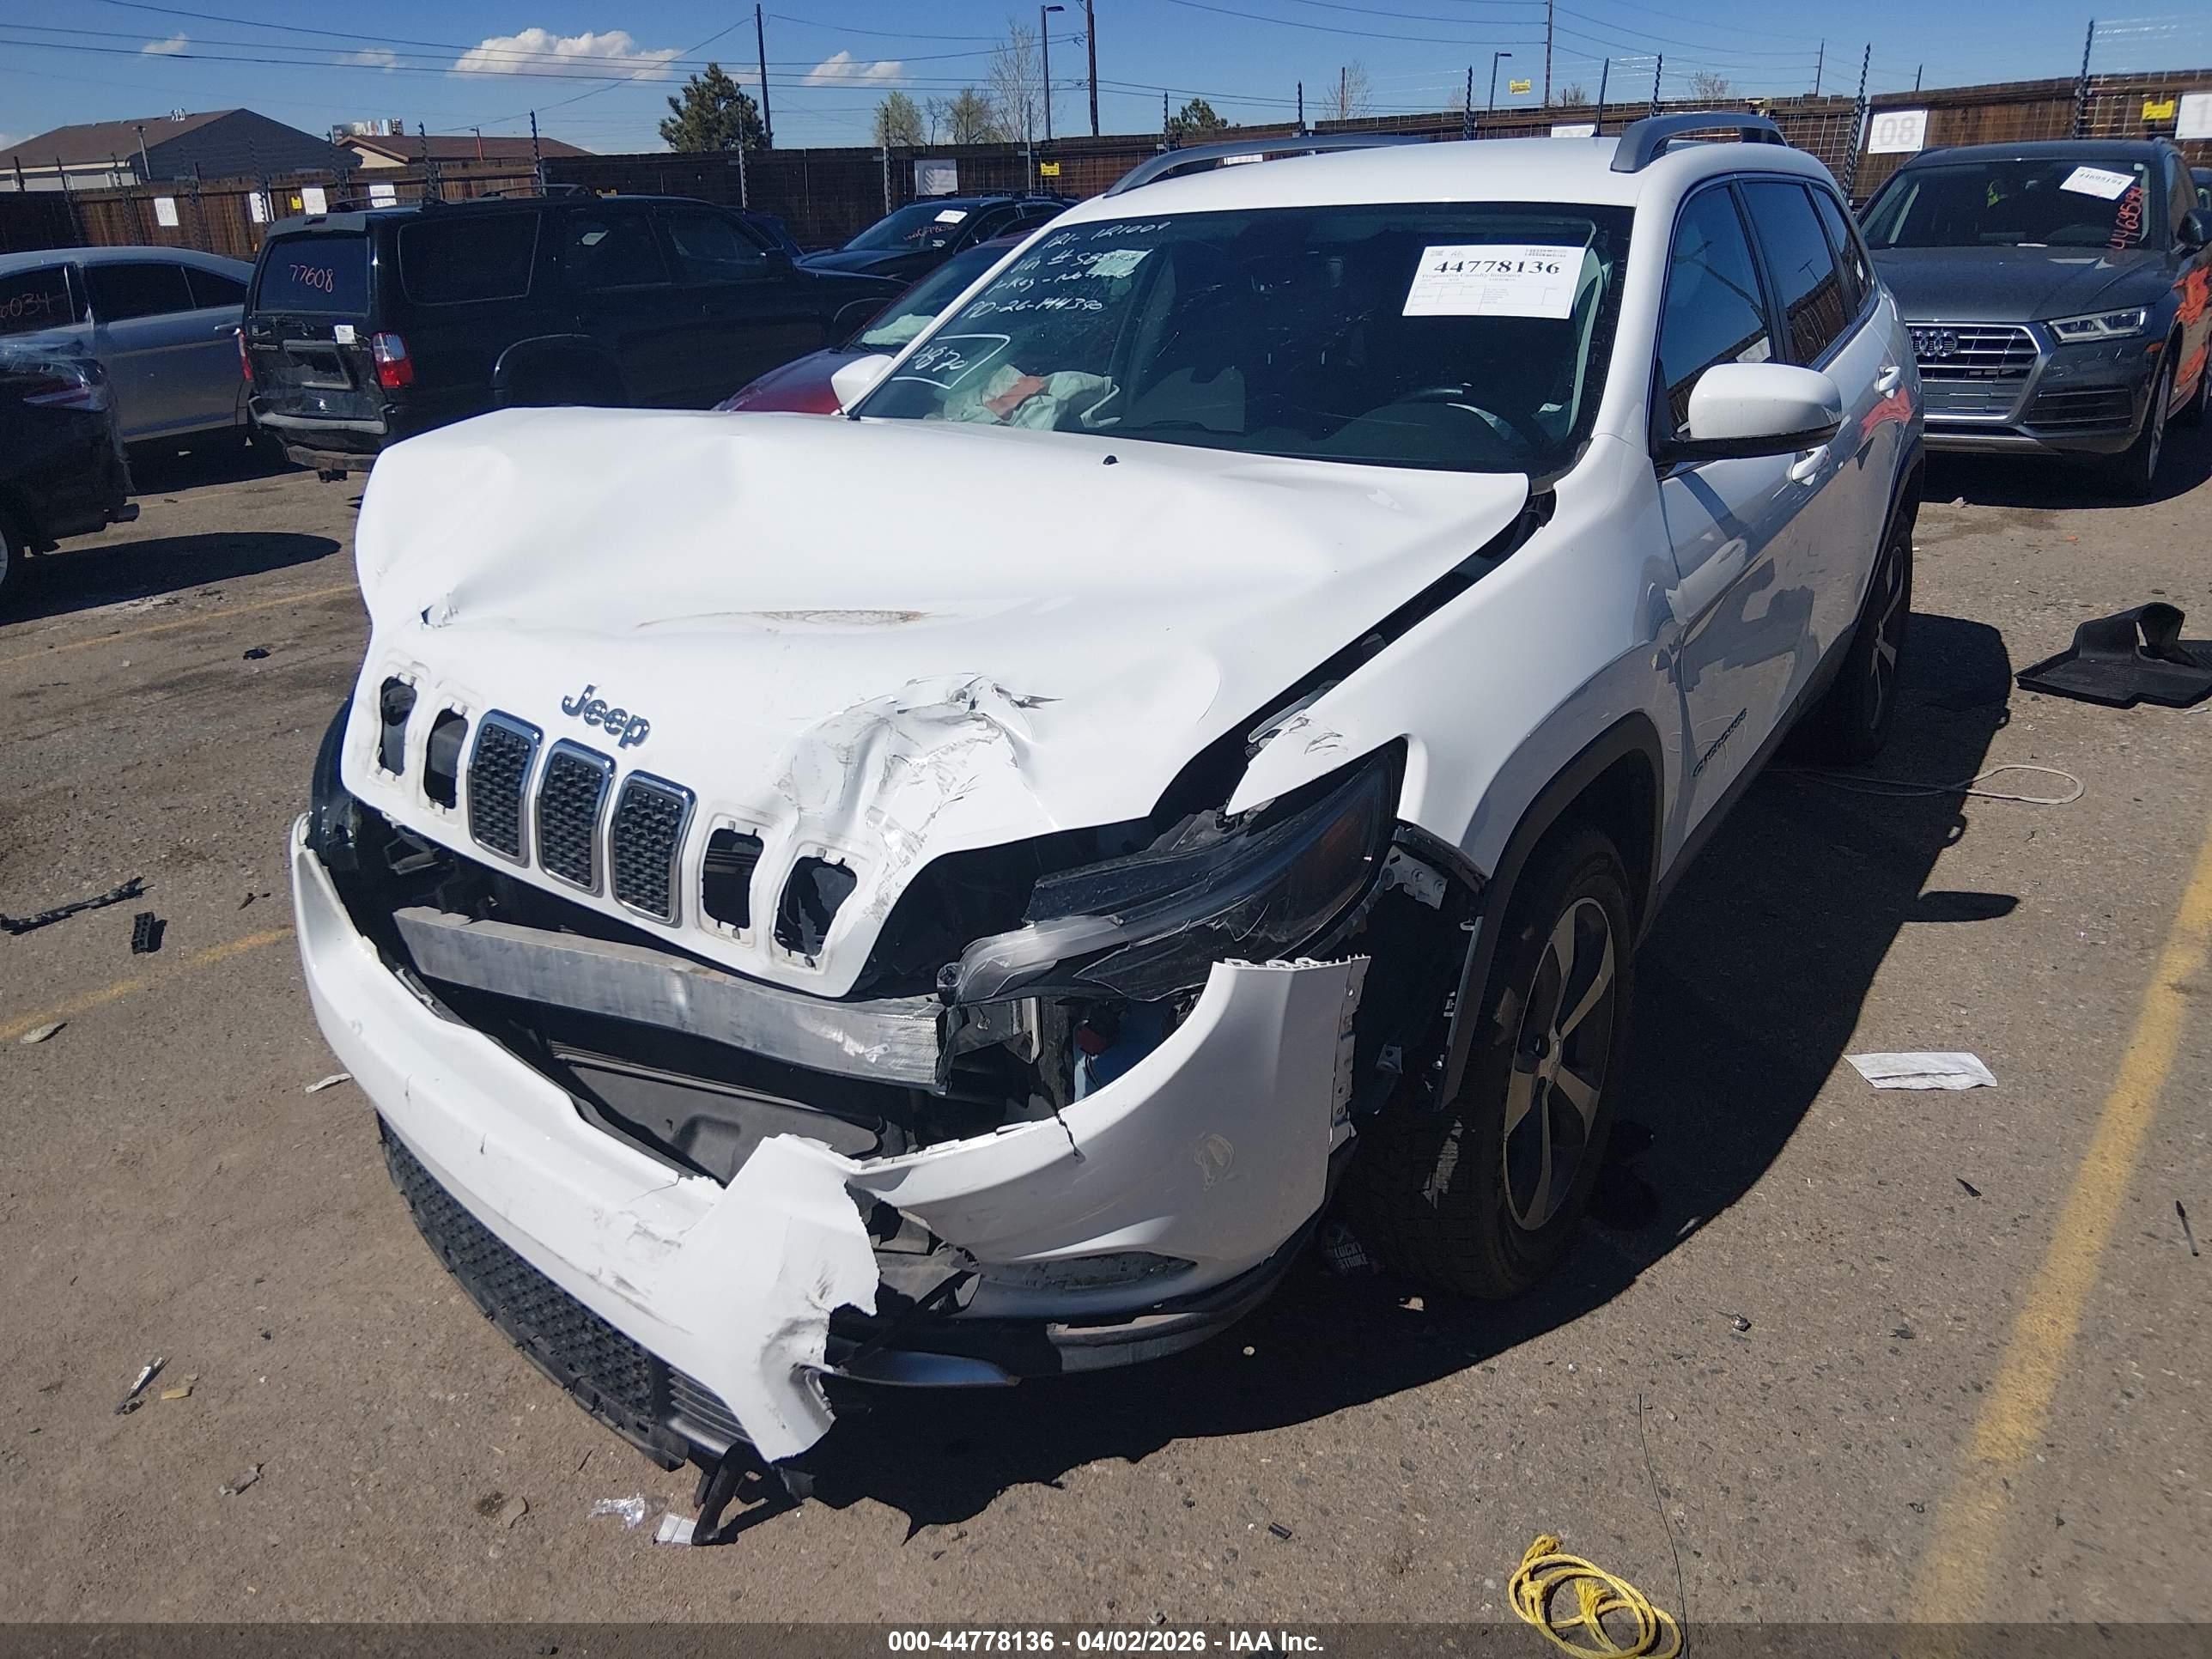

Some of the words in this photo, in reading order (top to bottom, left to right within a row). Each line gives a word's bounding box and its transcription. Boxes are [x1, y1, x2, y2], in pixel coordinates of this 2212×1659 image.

[1879, 115, 1917, 145] 08
[289, 264, 334, 293] 77608
[1433, 260, 1561, 275] 44778136
[562, 684, 650, 750] Jeep
